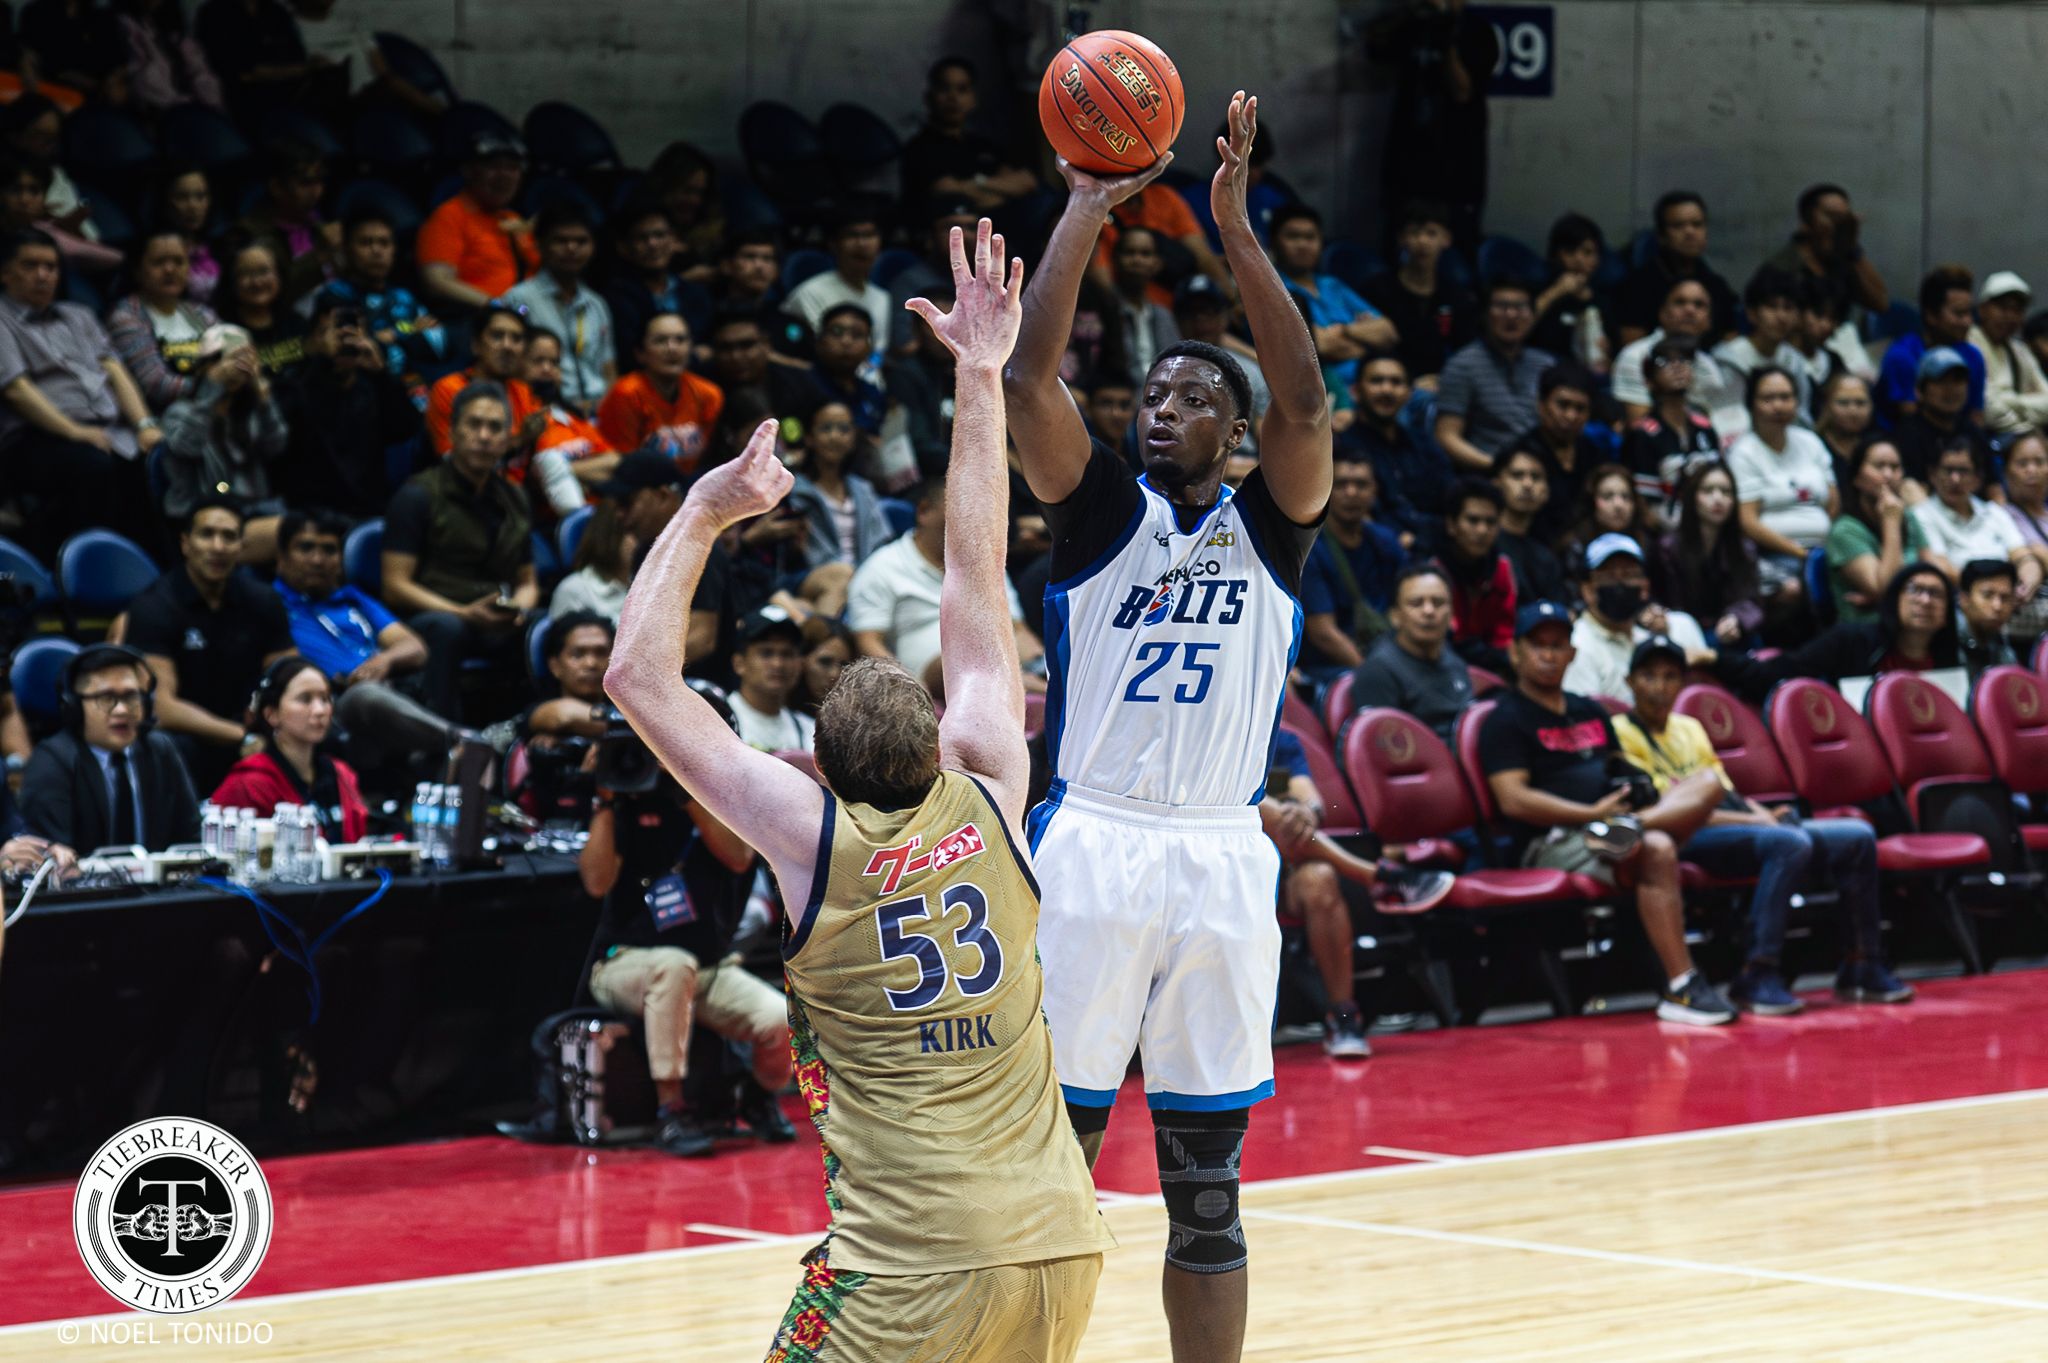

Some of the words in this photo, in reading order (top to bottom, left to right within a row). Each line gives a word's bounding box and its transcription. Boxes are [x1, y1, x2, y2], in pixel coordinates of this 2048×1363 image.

[1059, 62, 1138, 154] SPALDING
[1095, 52, 1160, 124] LEGACY
[1112, 579, 1249, 629] BOLTS
[1123, 641, 1221, 704] 25
[875, 881, 1004, 1011] 53
[919, 1014, 997, 1054] KIRK
